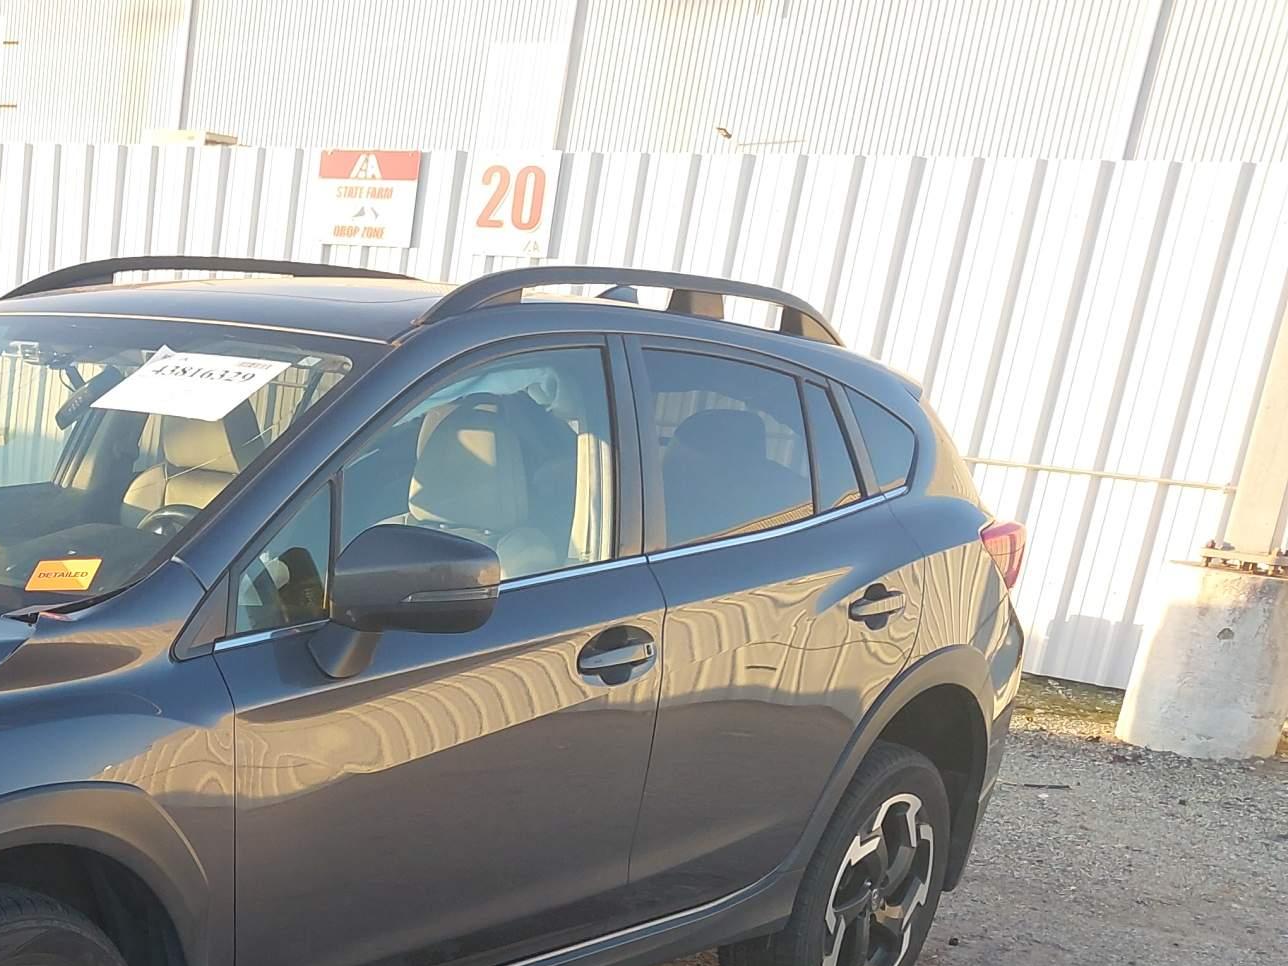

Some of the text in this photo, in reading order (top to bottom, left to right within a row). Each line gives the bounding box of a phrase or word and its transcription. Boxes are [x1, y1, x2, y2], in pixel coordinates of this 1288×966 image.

[336, 186, 394, 199] STATE FARM
[476, 165, 546, 231] 20
[333, 225, 360, 238] DROP
[151, 364, 256, 383] 43816329
[38, 571, 89, 579] DETAILED
